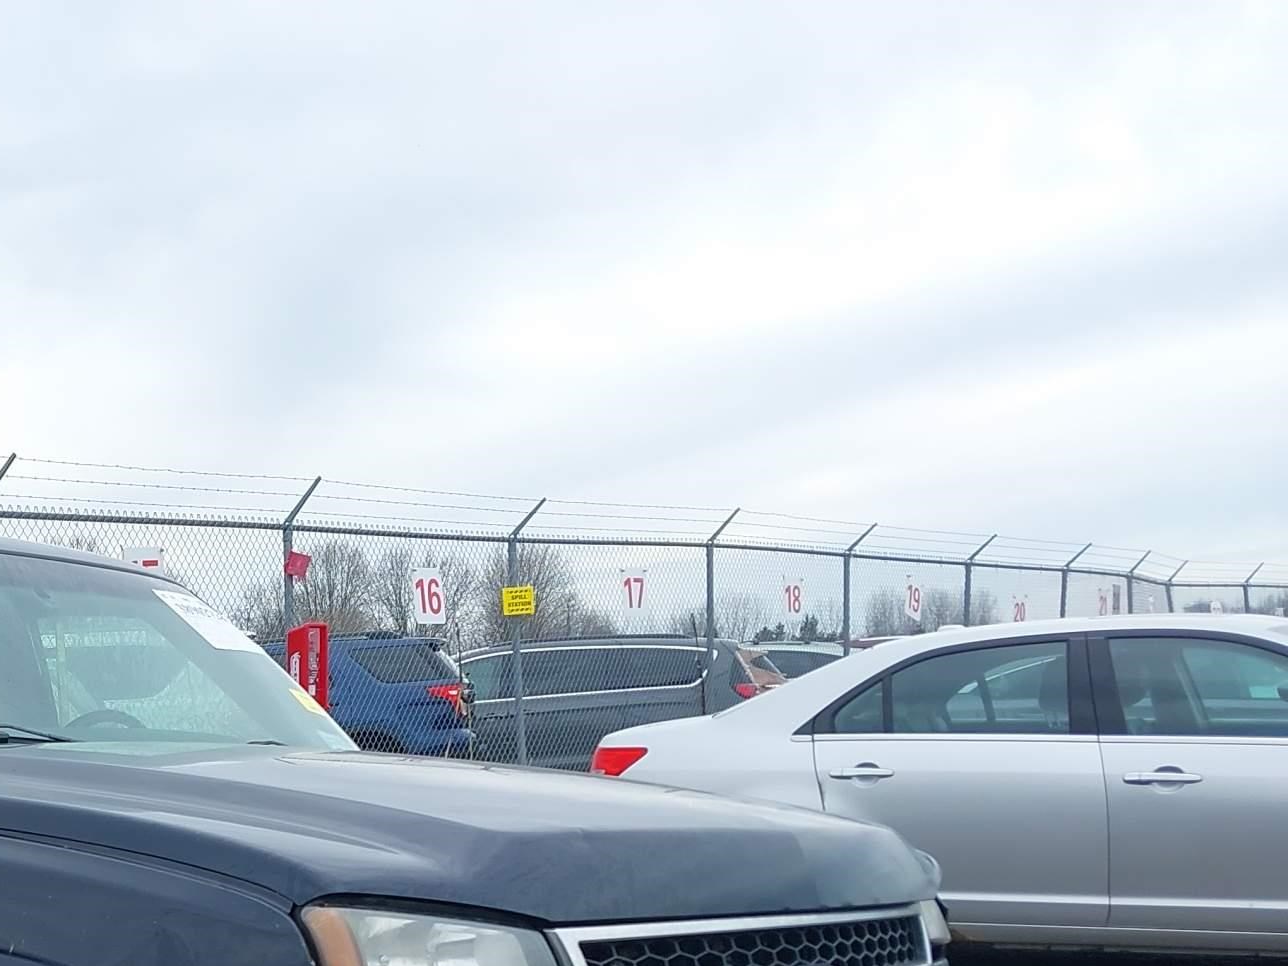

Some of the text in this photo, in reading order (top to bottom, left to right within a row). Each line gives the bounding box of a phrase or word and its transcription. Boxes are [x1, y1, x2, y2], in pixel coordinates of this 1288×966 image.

[415, 578, 442, 615] 16
[623, 577, 644, 609] 17
[785, 585, 802, 613] 18
[906, 584, 921, 613] 19
[1014, 601, 1026, 622] 20
